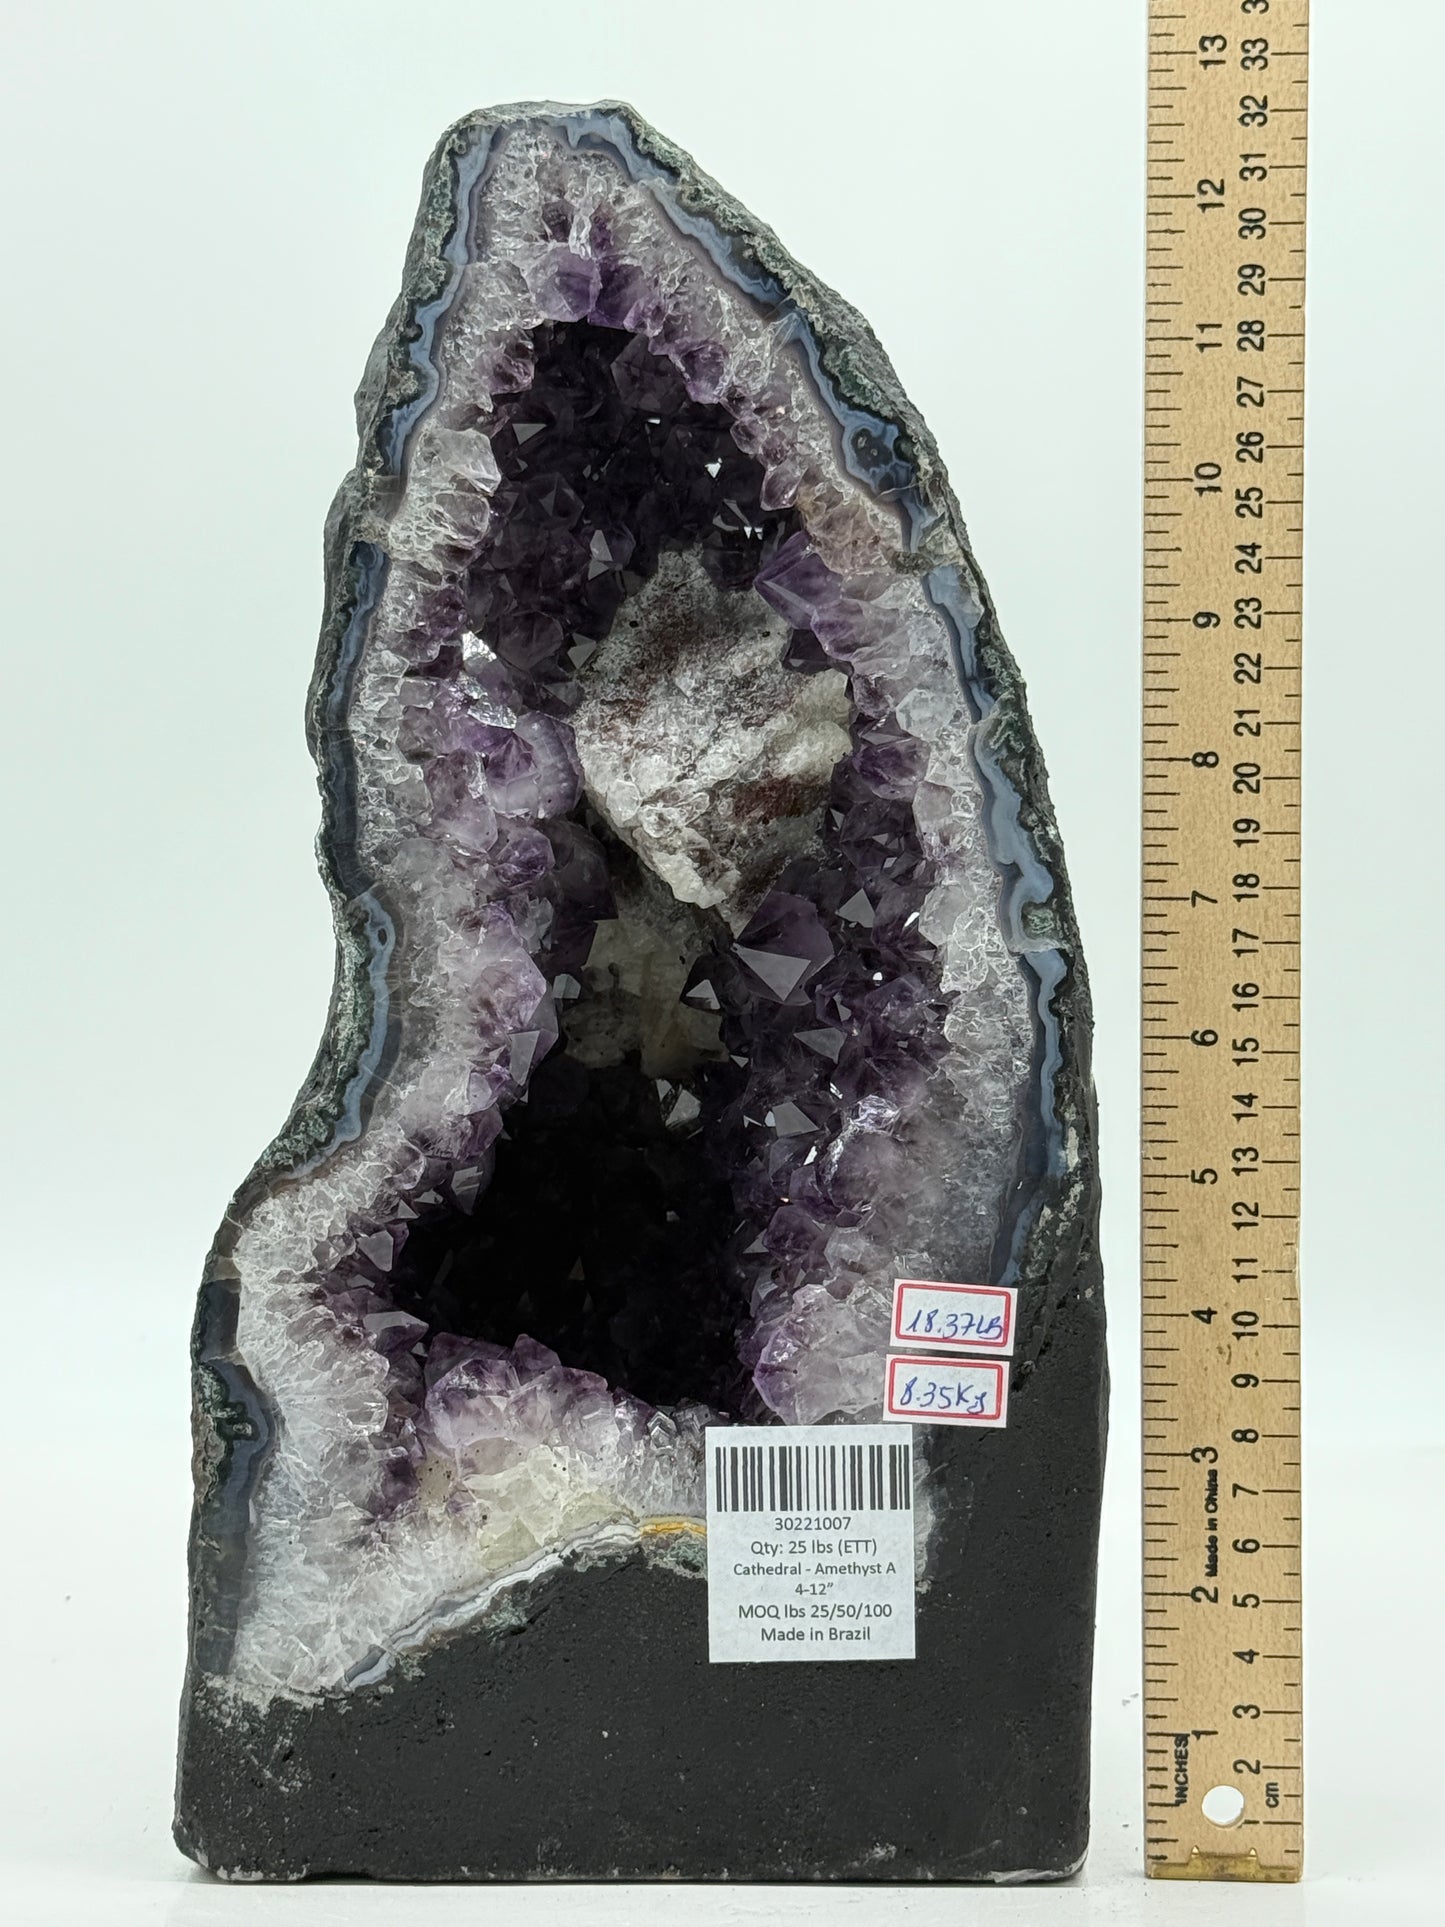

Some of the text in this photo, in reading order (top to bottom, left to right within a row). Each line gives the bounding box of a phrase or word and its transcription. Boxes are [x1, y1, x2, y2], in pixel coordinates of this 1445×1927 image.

[1199, 35, 1227, 70] 13
[1240, 38, 1269, 71] 33
[1238, 95, 1268, 127] 32
[1239, 153, 1267, 182] 31
[1197, 179, 1225, 213] 12
[1238, 207, 1266, 240] 30
[1237, 263, 1266, 296] 29
[1195, 323, 1223, 353] 11
[1237, 320, 1265, 352] 28
[1236, 376, 1264, 408] 27
[1236, 431, 1264, 464] 26
[1194, 462, 1223, 498] 10
[1235, 487, 1263, 519] 25
[1234, 542, 1263, 574] 24
[1192, 611, 1221, 629] 9
[1234, 597, 1262, 629] 23
[1233, 653, 1262, 685] 22
[1233, 709, 1261, 737] 21
[1192, 751, 1220, 769] 8
[1233, 762, 1261, 795] 20
[1232, 818, 1261, 849] 19
[1191, 890, 1219, 908] 7
[1232, 873, 1260, 903] 18
[1232, 928, 1260, 959] 17
[1232, 982, 1260, 1013] 16
[1191, 1029, 1219, 1047] 6
[1232, 1037, 1260, 1067] 15
[1231, 1092, 1259, 1122] 14
[1191, 1167, 1219, 1185] 5
[1231, 1147, 1260, 1177] 13
[1231, 1202, 1259, 1231] 12
[1231, 1258, 1259, 1284] 11
[1191, 1306, 1218, 1325] 4
[1231, 1311, 1260, 1341] 10
[1231, 1373, 1260, 1388] 9
[1231, 1428, 1260, 1444] 8
[1191, 1446, 1219, 1464] 3
[1232, 1483, 1259, 1498] 7
[774, 1516, 851, 1531] 30221007
[1204, 1518, 1218, 1531] in
[750, 1538, 877, 1557] Qty: 25 lbs (ETT)
[1204, 1535, 1218, 1577] Made
[1232, 1538, 1260, 1554] 6
[733, 1563, 802, 1576] Cathedral
[814, 1562, 882, 1577] Amethyst
[886, 1562, 896, 1575] A
[1191, 1586, 1219, 1604] 2
[1232, 1593, 1260, 1609] 5
[738, 1603, 893, 1621] MOQ lbs 25/50/100
[761, 1626, 871, 1641] Made in Brazil
[1233, 1649, 1260, 1665] 4
[1232, 1704, 1261, 1719] 3
[1191, 1730, 1219, 1741] 1
[1174, 1734, 1189, 1806] INCHES
[1233, 1759, 1261, 1775] 2
[1265, 1782, 1279, 1809] cm
